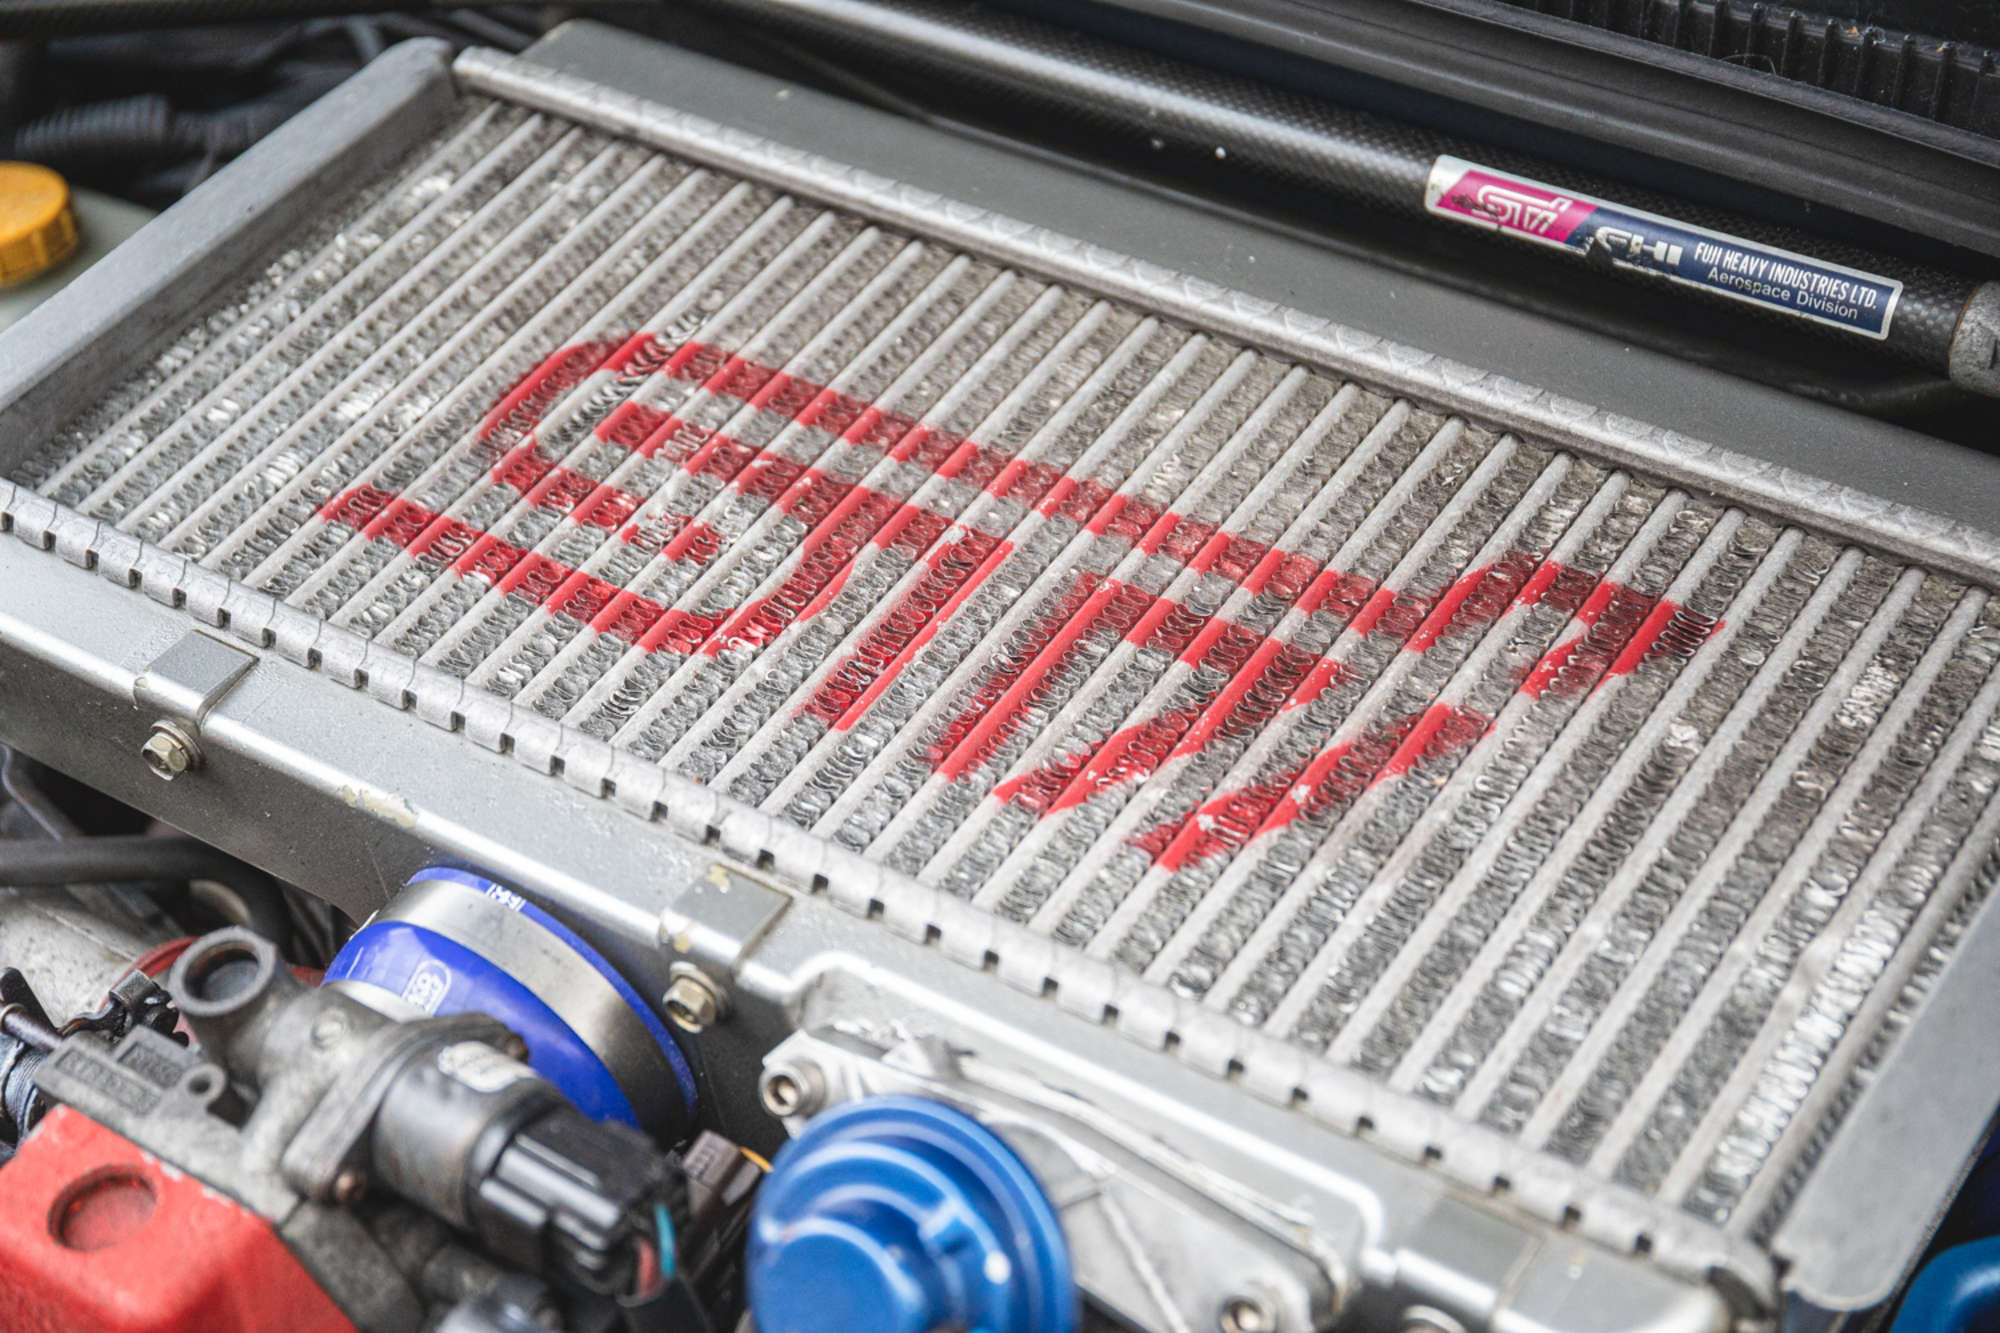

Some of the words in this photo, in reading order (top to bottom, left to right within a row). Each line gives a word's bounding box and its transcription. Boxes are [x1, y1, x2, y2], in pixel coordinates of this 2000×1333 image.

[1694, 242, 1721, 268] FUJI
[1723, 249, 1771, 278] HEAVY
[1768, 262, 1850, 301] INDUSTRIES
[1850, 284, 1878, 310] LTD.
[1708, 267, 1791, 301] Aerospace
[1796, 290, 1859, 320] Division
